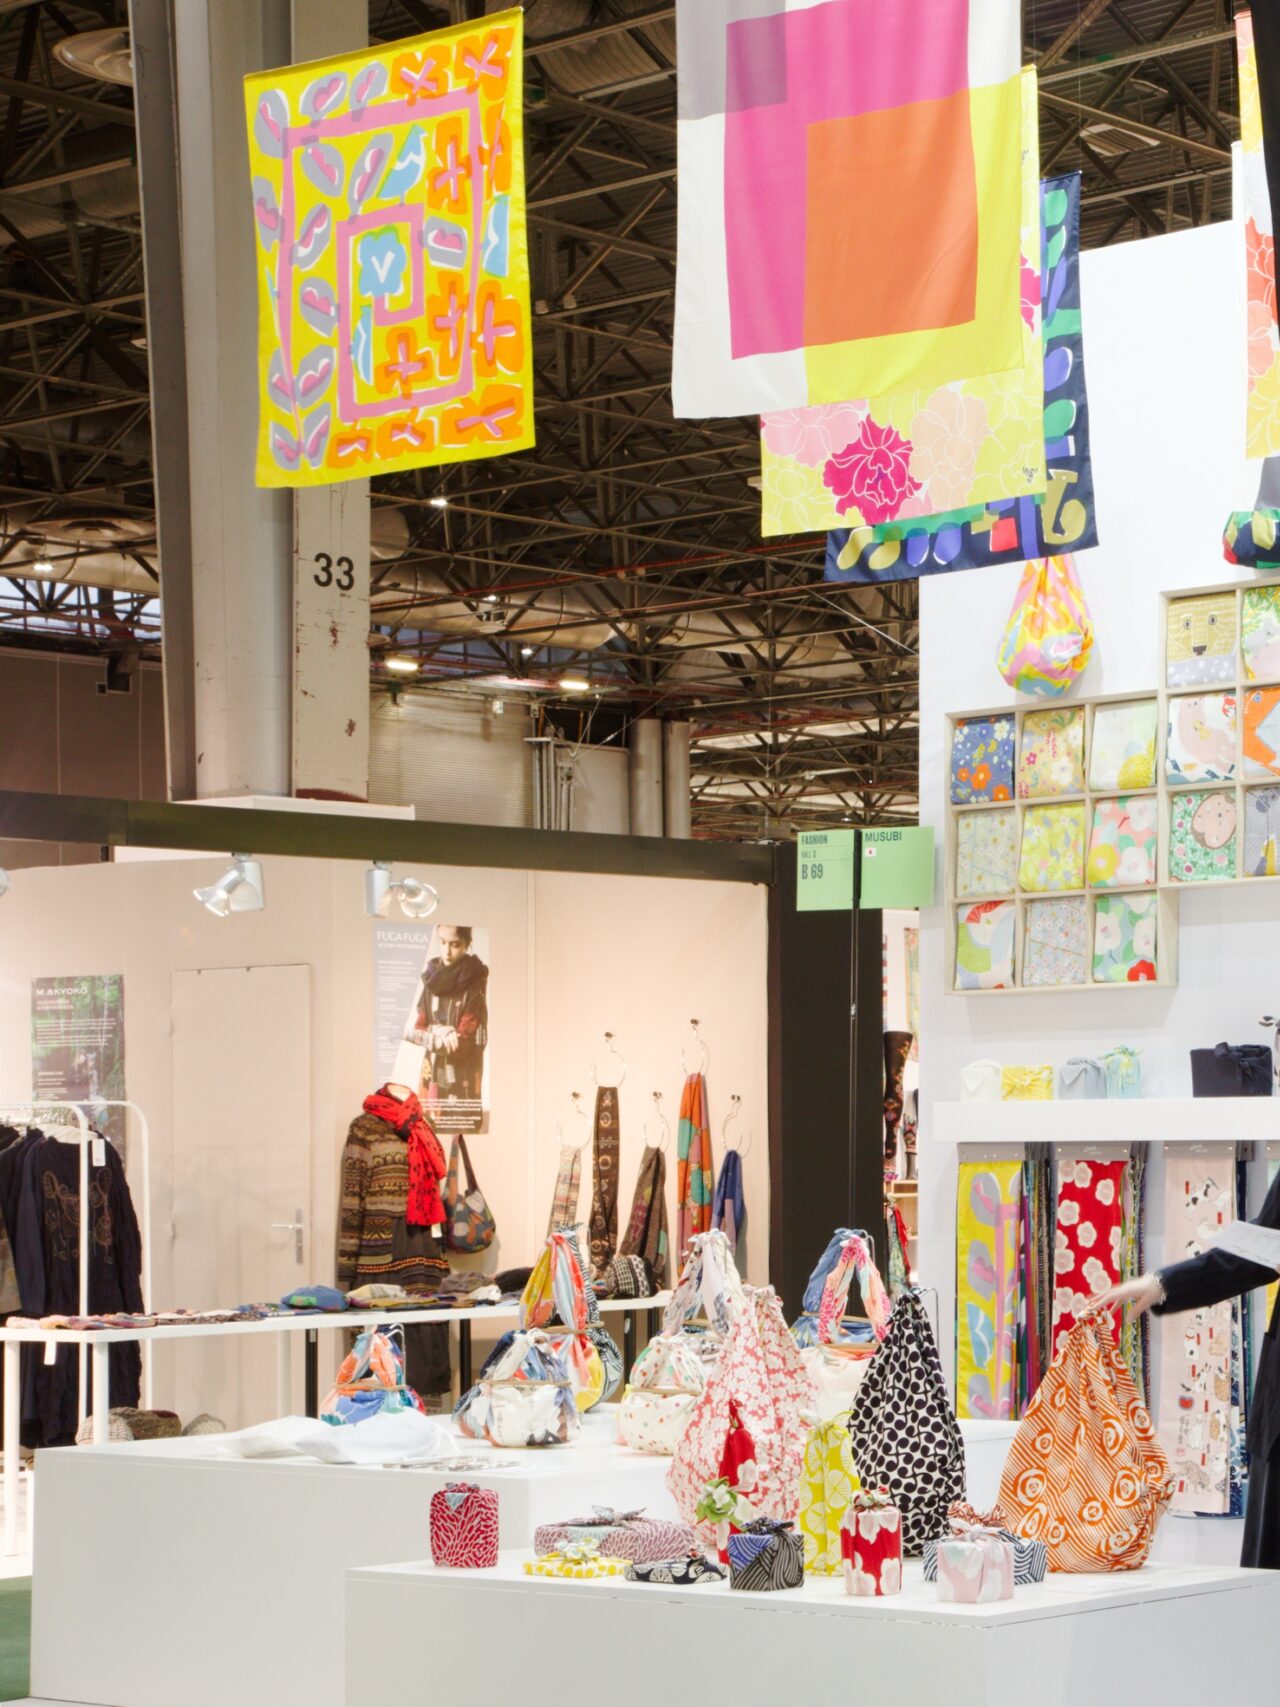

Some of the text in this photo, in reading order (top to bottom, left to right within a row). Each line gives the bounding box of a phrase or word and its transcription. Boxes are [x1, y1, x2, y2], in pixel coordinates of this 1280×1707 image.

[313, 552, 355, 591] 33
[801, 834, 828, 845] FASHION
[865, 831, 902, 842] MUSUBI
[801, 863, 823, 880] B 69
